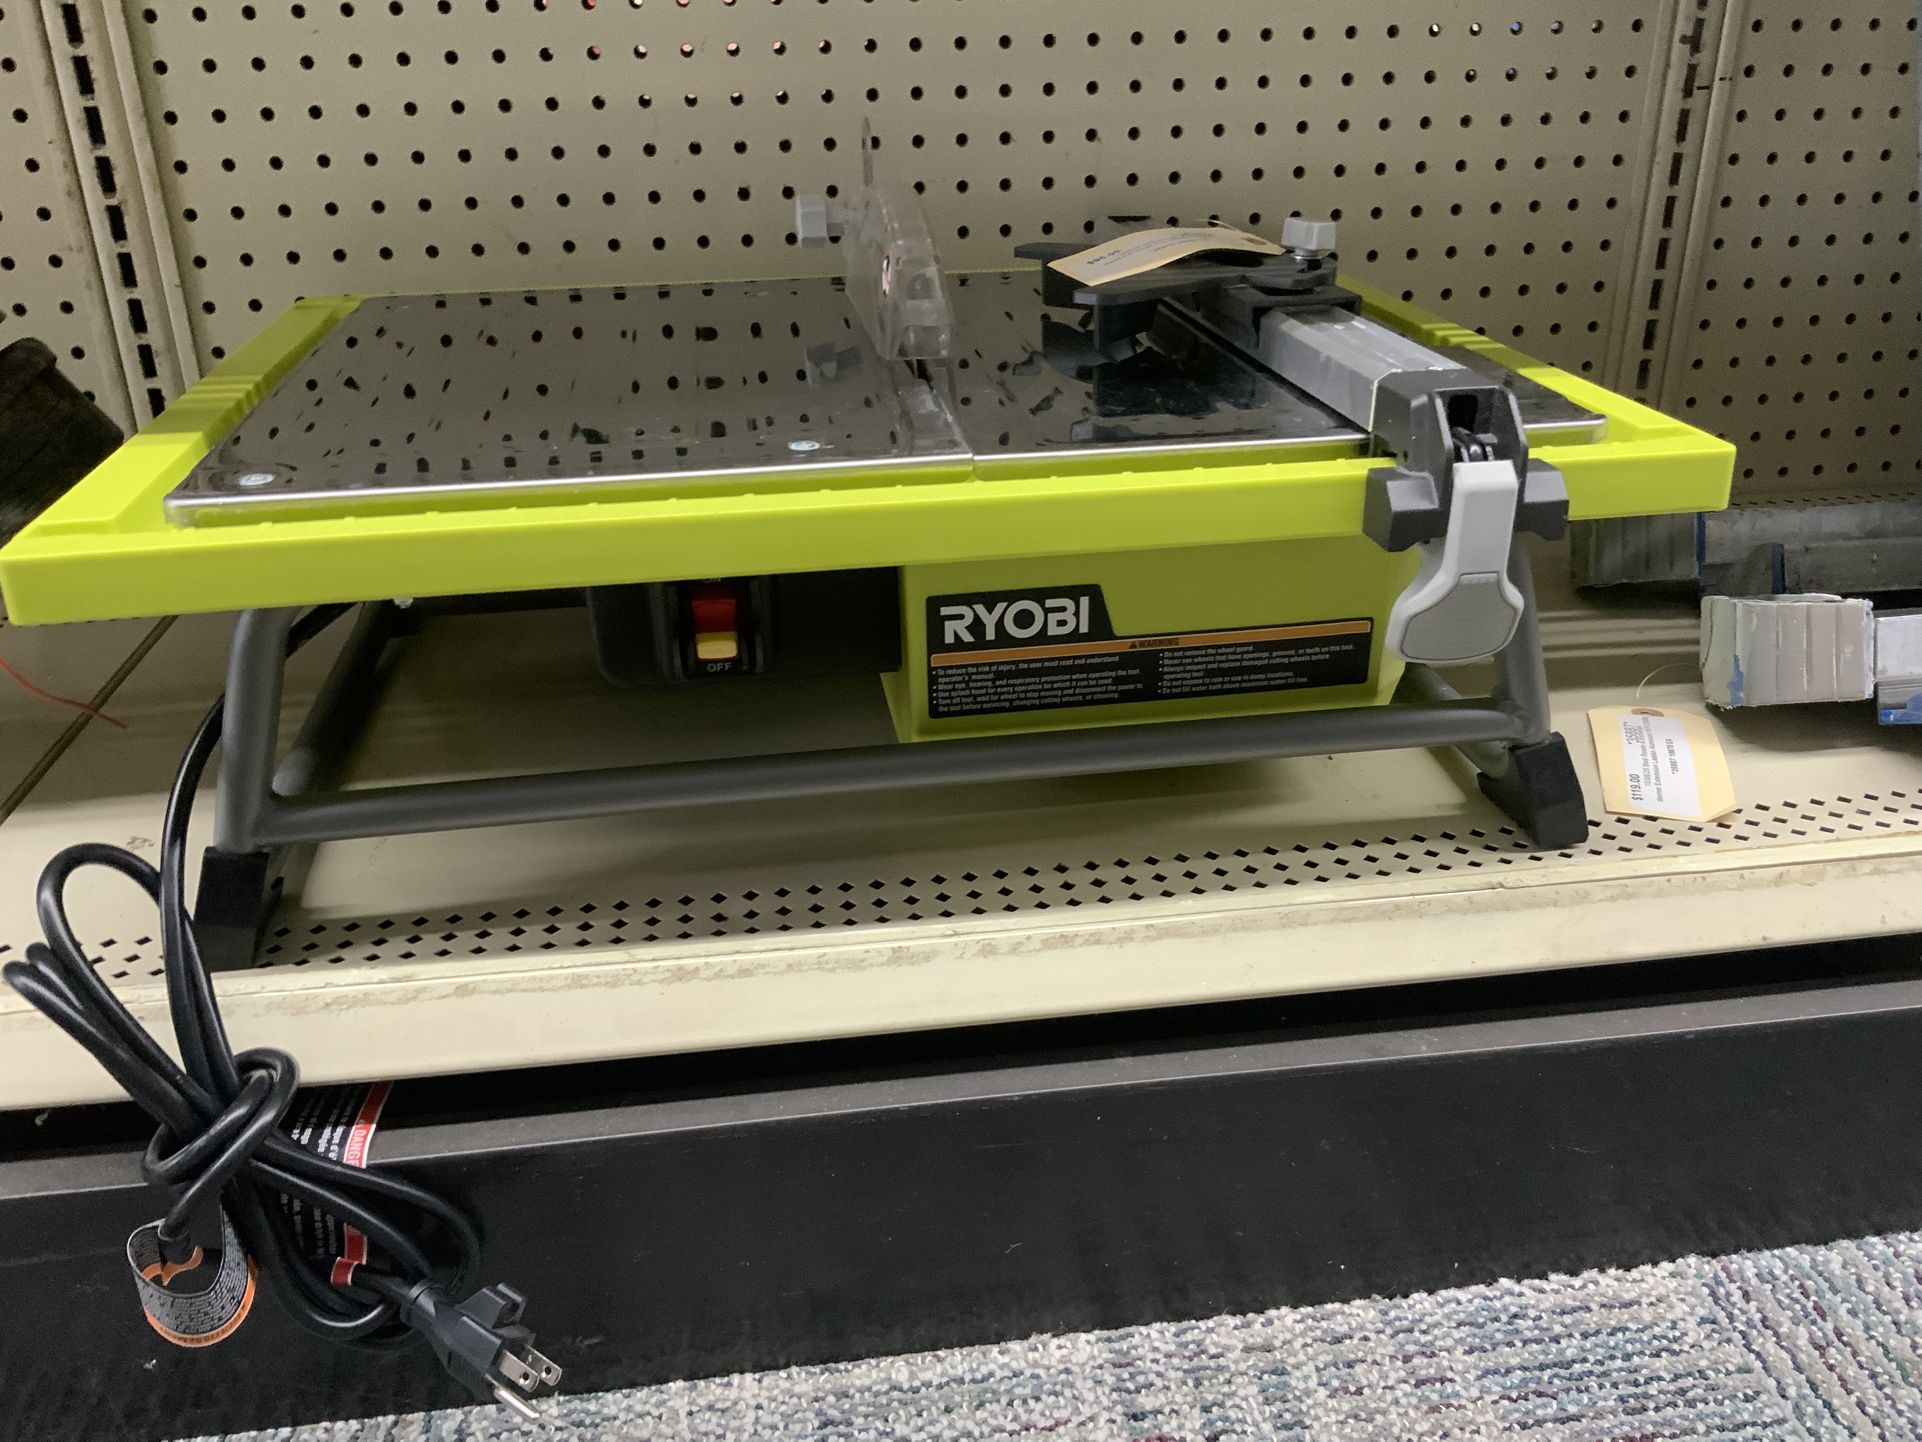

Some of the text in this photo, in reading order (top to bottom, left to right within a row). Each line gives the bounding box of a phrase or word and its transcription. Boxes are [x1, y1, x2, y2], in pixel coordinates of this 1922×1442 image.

[940, 596, 1090, 644] RYOBI
[1139, 638, 1179, 649] WARNING
[707, 662, 732, 672] OFF
[1650, 750, 1658, 764] Ladder
[1653, 764, 1662, 786] Extension
[1628, 773, 1644, 801] $119.00
[347, 1129, 367, 1166] DANGE
